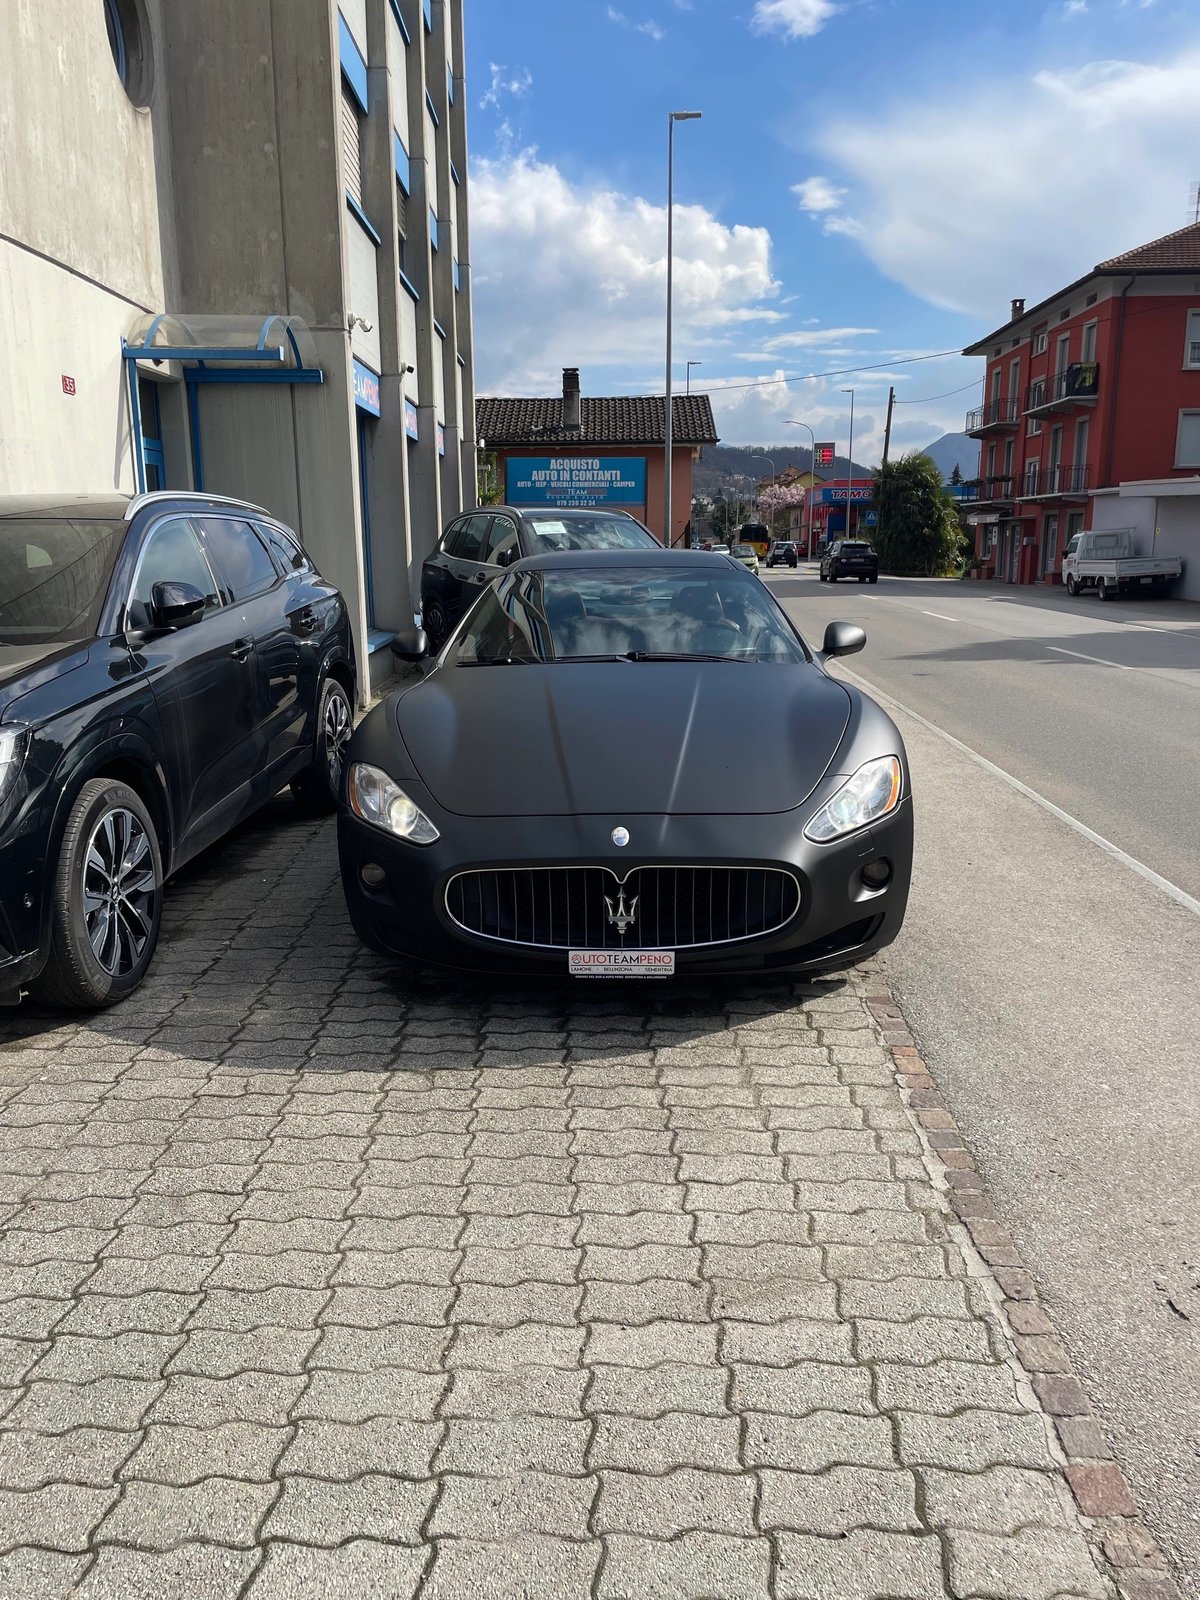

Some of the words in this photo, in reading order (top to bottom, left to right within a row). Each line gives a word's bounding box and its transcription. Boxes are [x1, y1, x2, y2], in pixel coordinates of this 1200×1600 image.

[64, 377, 74, 392] 35
[550, 459, 600, 471] ACQUISTO
[531, 470, 557, 481] AUTO
[560, 470, 570, 481] IN
[572, 470, 621, 481] CONTANTI
